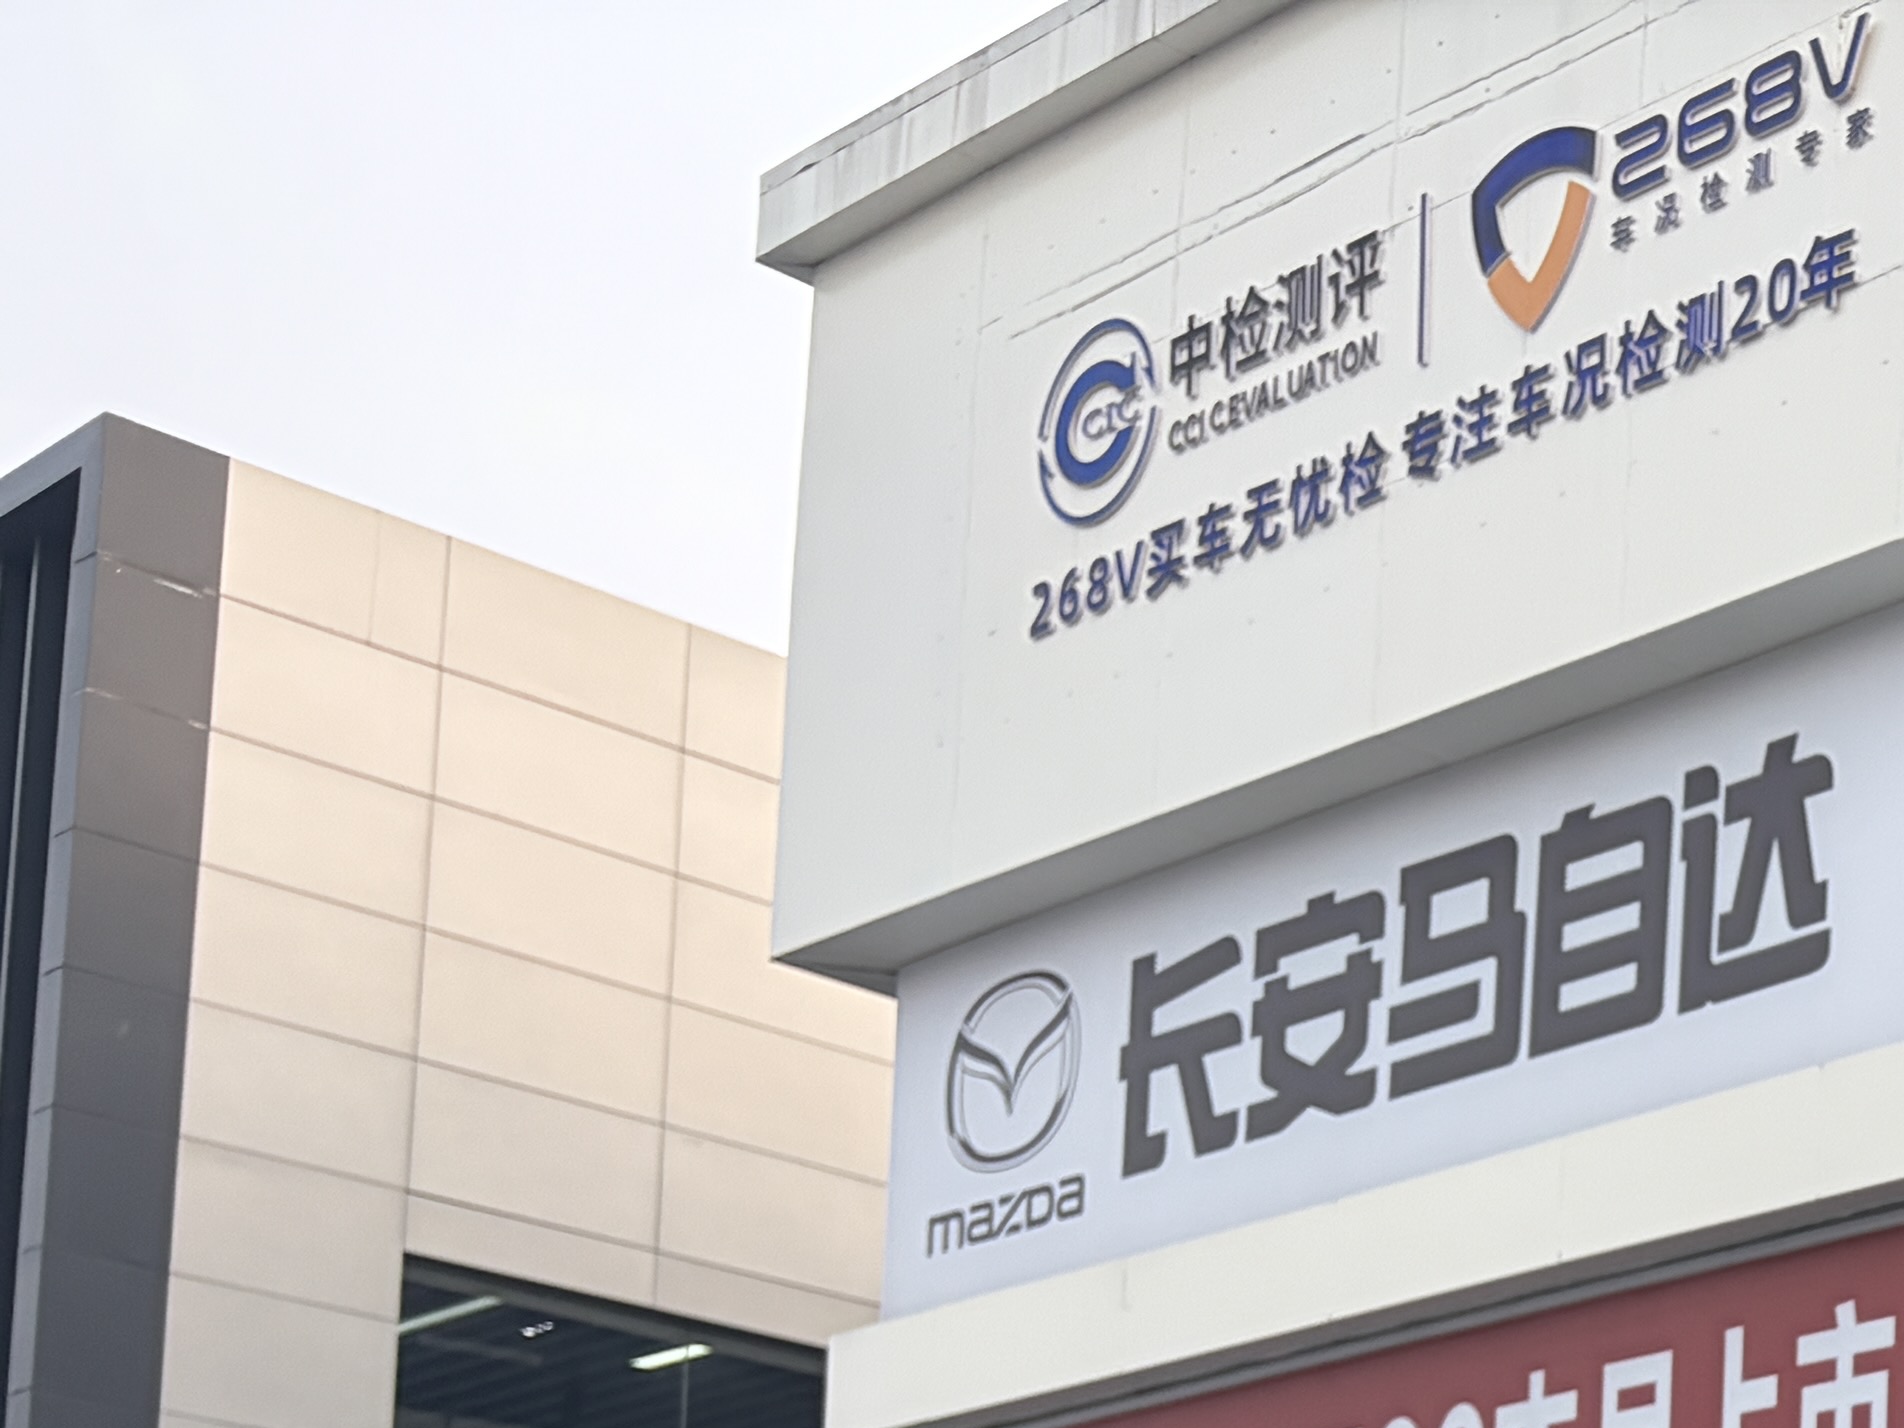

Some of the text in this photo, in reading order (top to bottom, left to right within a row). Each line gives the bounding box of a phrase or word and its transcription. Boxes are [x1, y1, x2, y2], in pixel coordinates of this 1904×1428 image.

[1609, 106, 1877, 254] 车况检测专家
[1612, 12, 1870, 202] 268V
[1168, 229, 1386, 400] 中检测评
[1402, 226, 1862, 482] 专注车况检测20年
[1118, 731, 1836, 1180] 长安马自达
